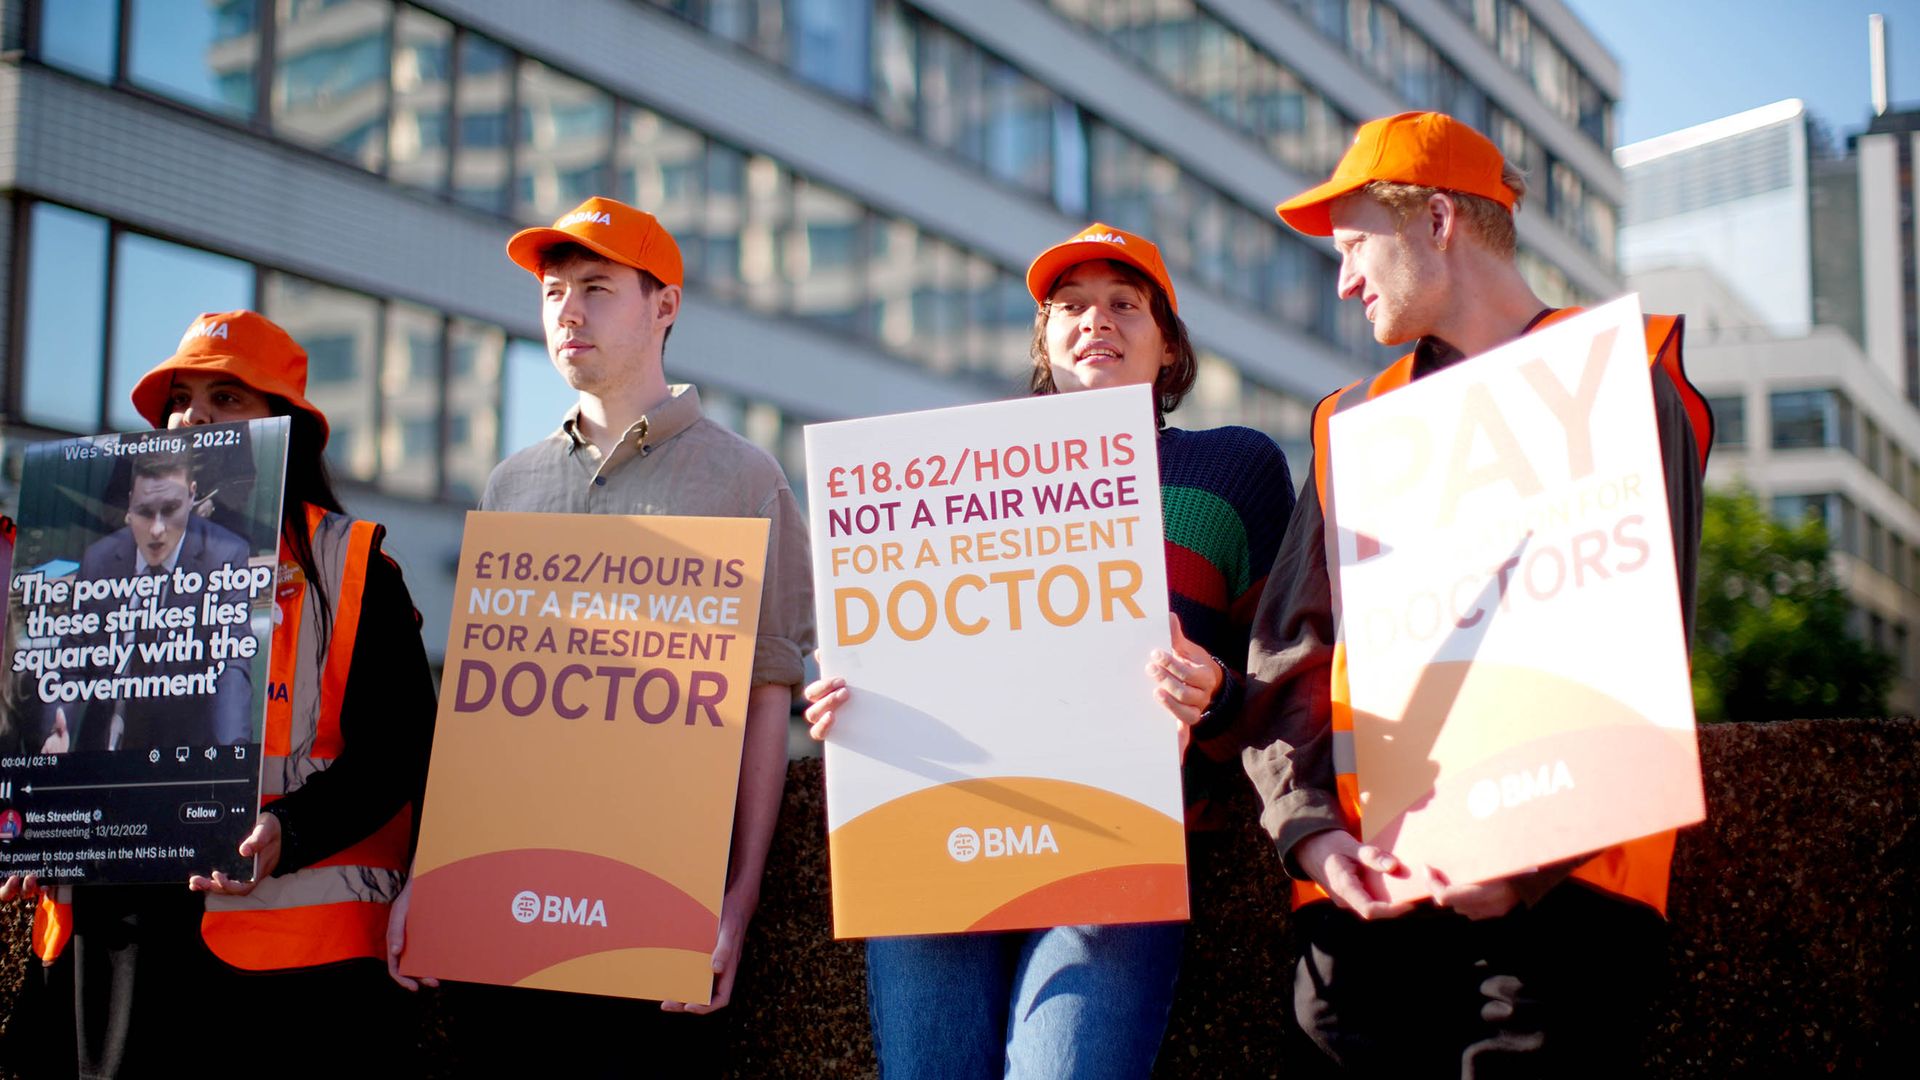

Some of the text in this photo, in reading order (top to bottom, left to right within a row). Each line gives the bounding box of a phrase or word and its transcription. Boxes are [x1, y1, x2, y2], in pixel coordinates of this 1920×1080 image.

[198, 320, 229, 340] MA
[65, 430, 241, 460] Wes Streeting, 2022:
[1350, 325, 1621, 561] PAY
[827, 433, 1136, 498] £18.62/HOUR IS
[829, 475, 1139, 538] NOT A FAIR WAGE
[831, 516, 1140, 577] FOR A RESIDENT
[12, 571, 69, 604] ‘The
[73, 573, 168, 610] power
[173, 566, 202, 595] to
[208, 562, 271, 597] stop
[475, 551, 745, 589] £18.62/HOUR IS
[27, 593, 248, 638] these strikes lies
[468, 587, 741, 625] NOT A FAIR WAGE
[834, 559, 1147, 647] DOCTOR
[12, 625, 258, 678] squarely with the
[463, 623, 736, 662] FOR A RESIDENT
[38, 661, 226, 703] Government’
[267, 681, 289, 702] MA
[454, 659, 729, 727] DOCTOR
[1, 757, 26, 768] 00:04
[32, 755, 58, 767] 02:19
[25, 809, 91, 824] Wes Streeting
[186, 807, 217, 818] Follow
[24, 824, 148, 840] @wesstreeting 13/12/2022
[984, 824, 1059, 857] BMA
[0, 846, 195, 864] he power to stop strikes in the NHS is in the
[0, 865, 85, 878] overnment's hands.
[542, 895, 608, 927] BMA
